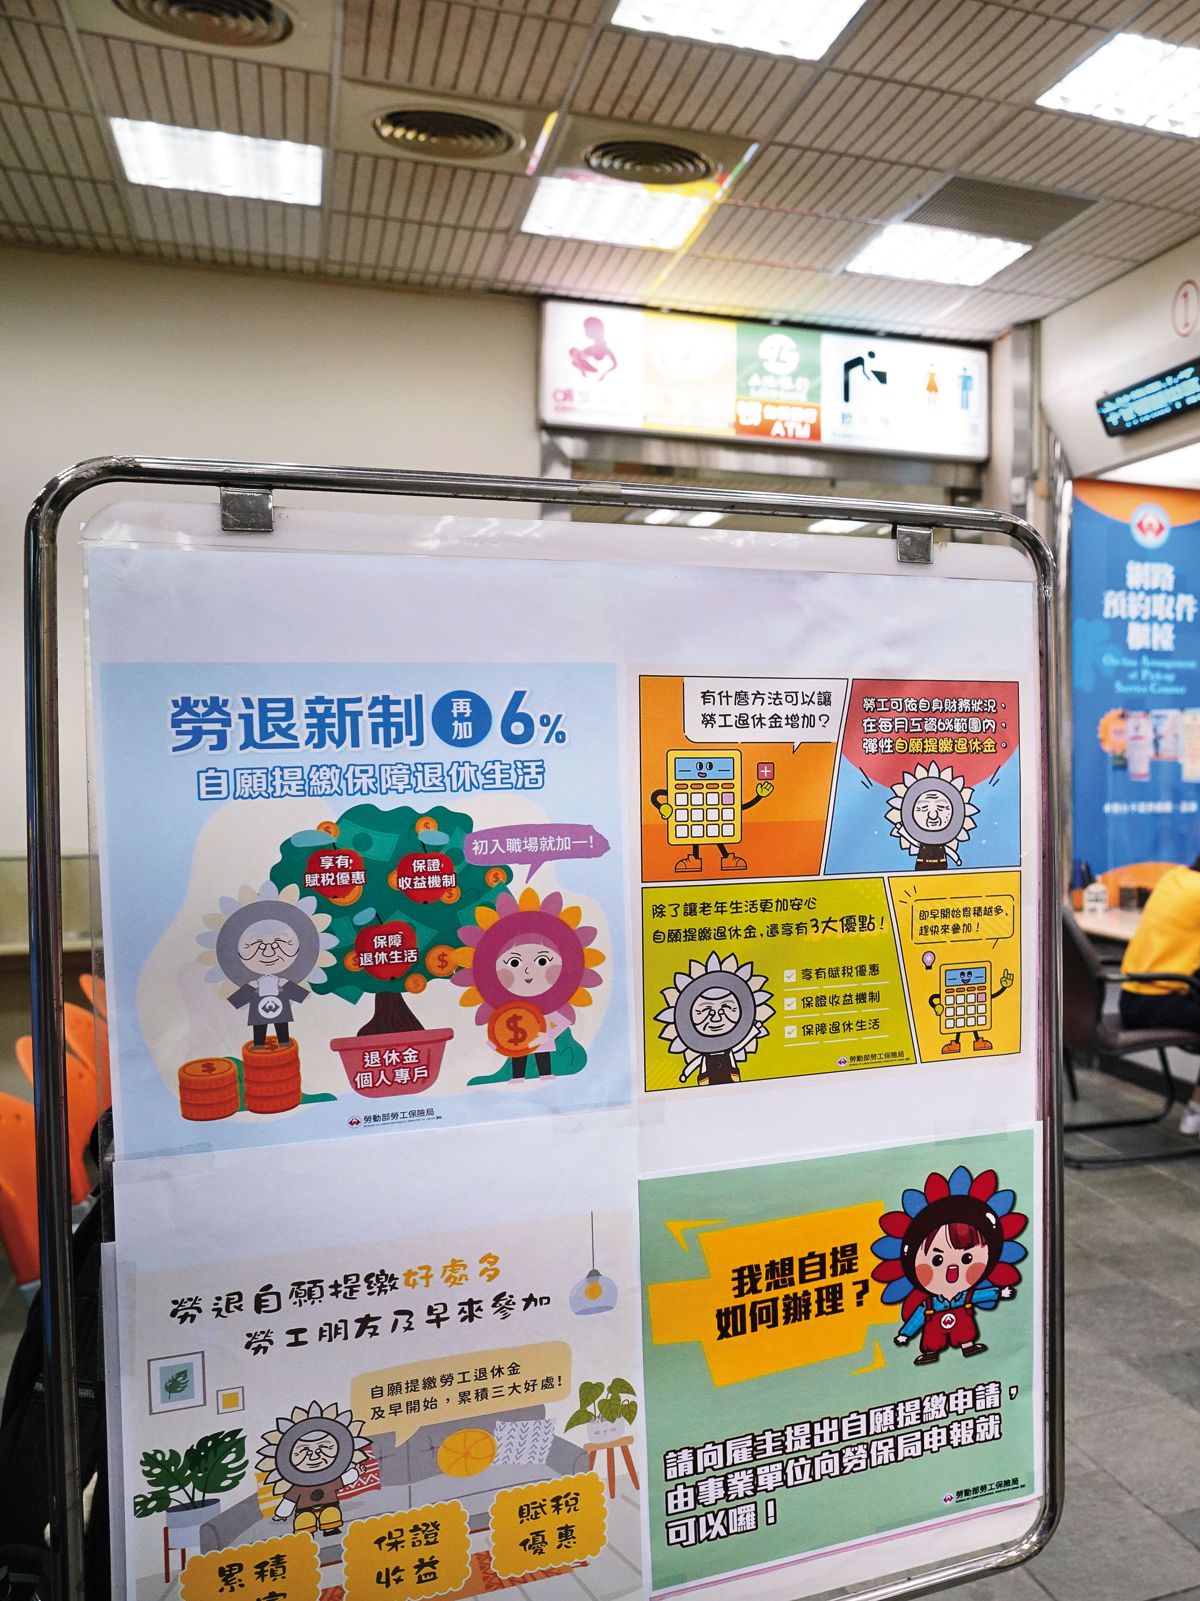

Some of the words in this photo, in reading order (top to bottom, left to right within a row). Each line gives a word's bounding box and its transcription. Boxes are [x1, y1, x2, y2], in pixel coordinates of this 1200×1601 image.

[770, 420, 811, 439] ATM
[700, 690, 832, 707] 有什麼方法可以讓
[170, 694, 424, 752] 勞退新制
[450, 697, 474, 742] 再加
[500, 690, 567, 745] 6%
[701, 713, 831, 729] 勞工退休金增加？
[198, 760, 545, 801] 自願提繳保障退休生活
[320, 854, 350, 870] 享有
[411, 858, 442, 873] 保證
[305, 869, 366, 888] 賦稅優惠
[398, 872, 457, 891] 收益機制
[652, 897, 817, 919] 除了讓老年生活更加安心
[373, 934, 404, 950] 保障
[359, 948, 419, 967] 退休生活
[801, 963, 881, 981] 享有賦稅優惠
[801, 991, 881, 1009] 保證收益機制
[802, 1018, 880, 1037] 保障退休生活
[363, 1047, 421, 1070] 退休金
[354, 1066, 429, 1090] 個人專戶
[363, 1107, 435, 1124] 勞動部勞工保險局
[731, 1242, 860, 1299] 我想自提
[170, 1252, 502, 1324] 勞退自願提繳好處多
[715, 1279, 870, 1342] 如何辦理？
[244, 1293, 551, 1357] 勞工朋友及早來參加
[370, 1361, 522, 1401] 自願提繳勞工退休金
[666, 1414, 1002, 1517] 由事業單位向勞保局申報就
[517, 1491, 581, 1525] 賦稅
[373, 1520, 441, 1553] 保證
[518, 1524, 577, 1557] 優惠
[217, 1553, 288, 1593] 累積
[375, 1555, 440, 1589] 收益
